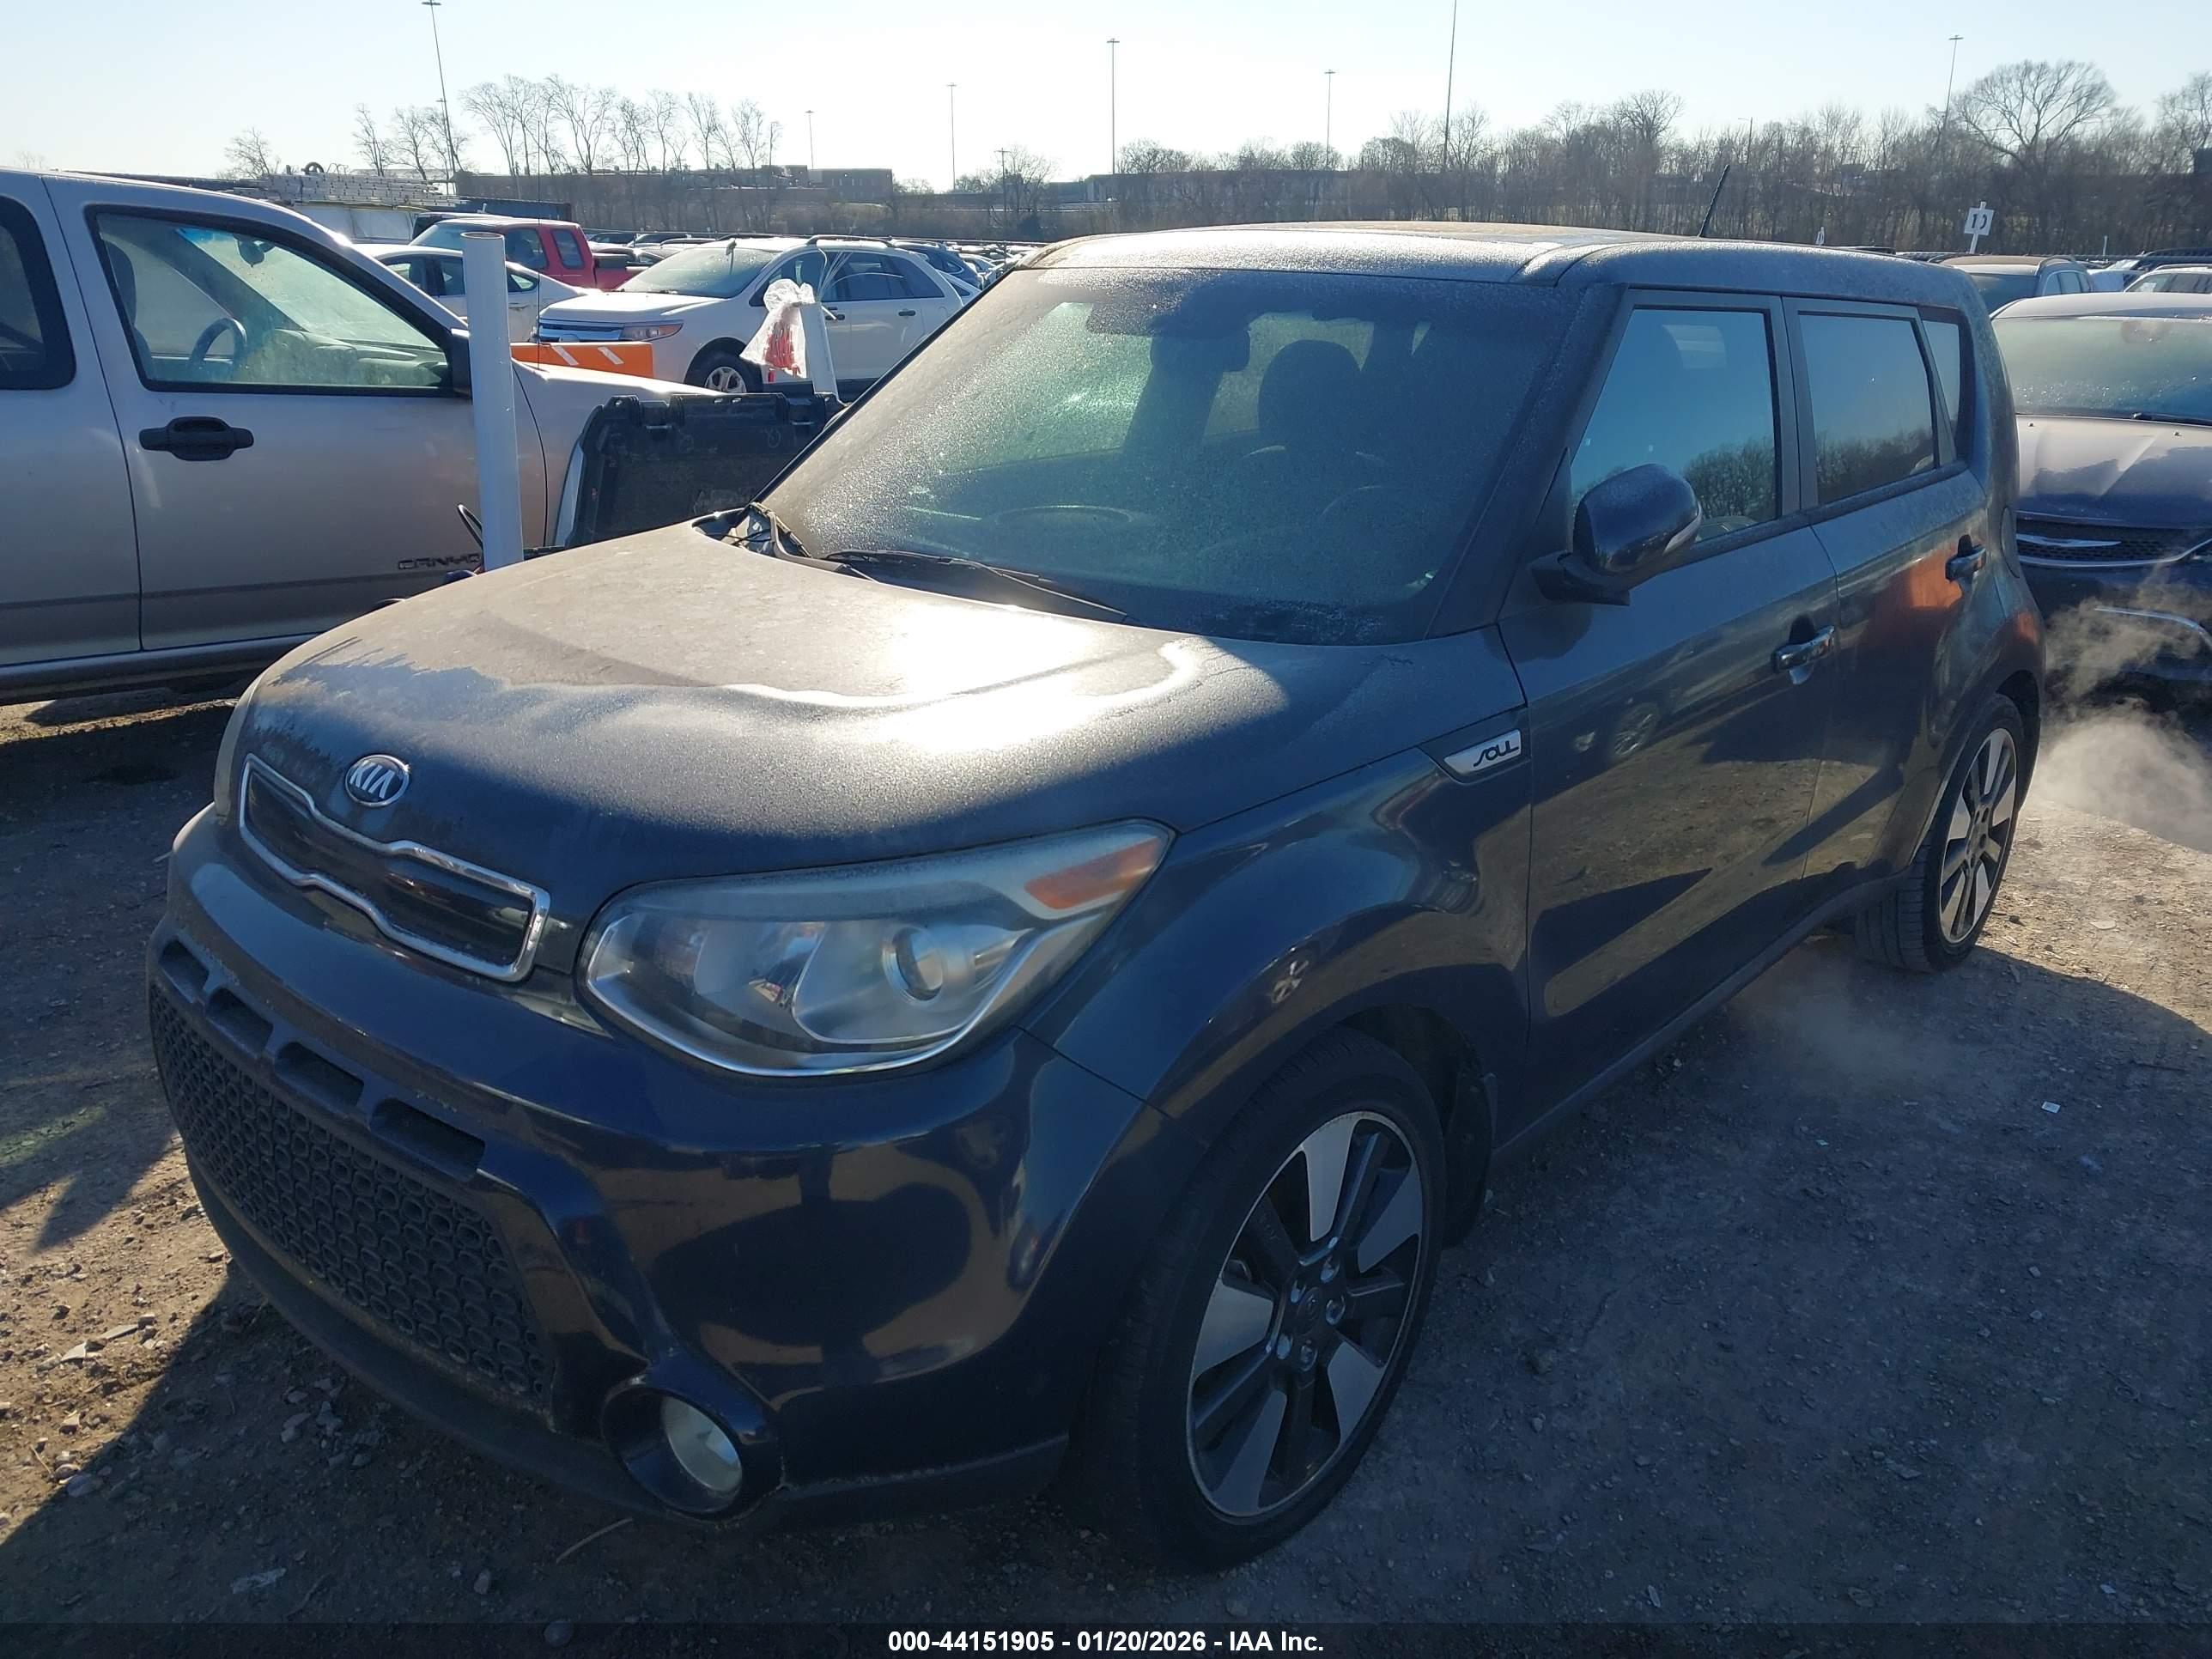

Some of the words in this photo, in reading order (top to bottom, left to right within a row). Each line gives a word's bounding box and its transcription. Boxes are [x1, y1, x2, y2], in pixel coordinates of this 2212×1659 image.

[398, 553, 481, 570] CANYO
[1473, 739, 1520, 768] SOUL
[349, 760, 396, 799] KIA
